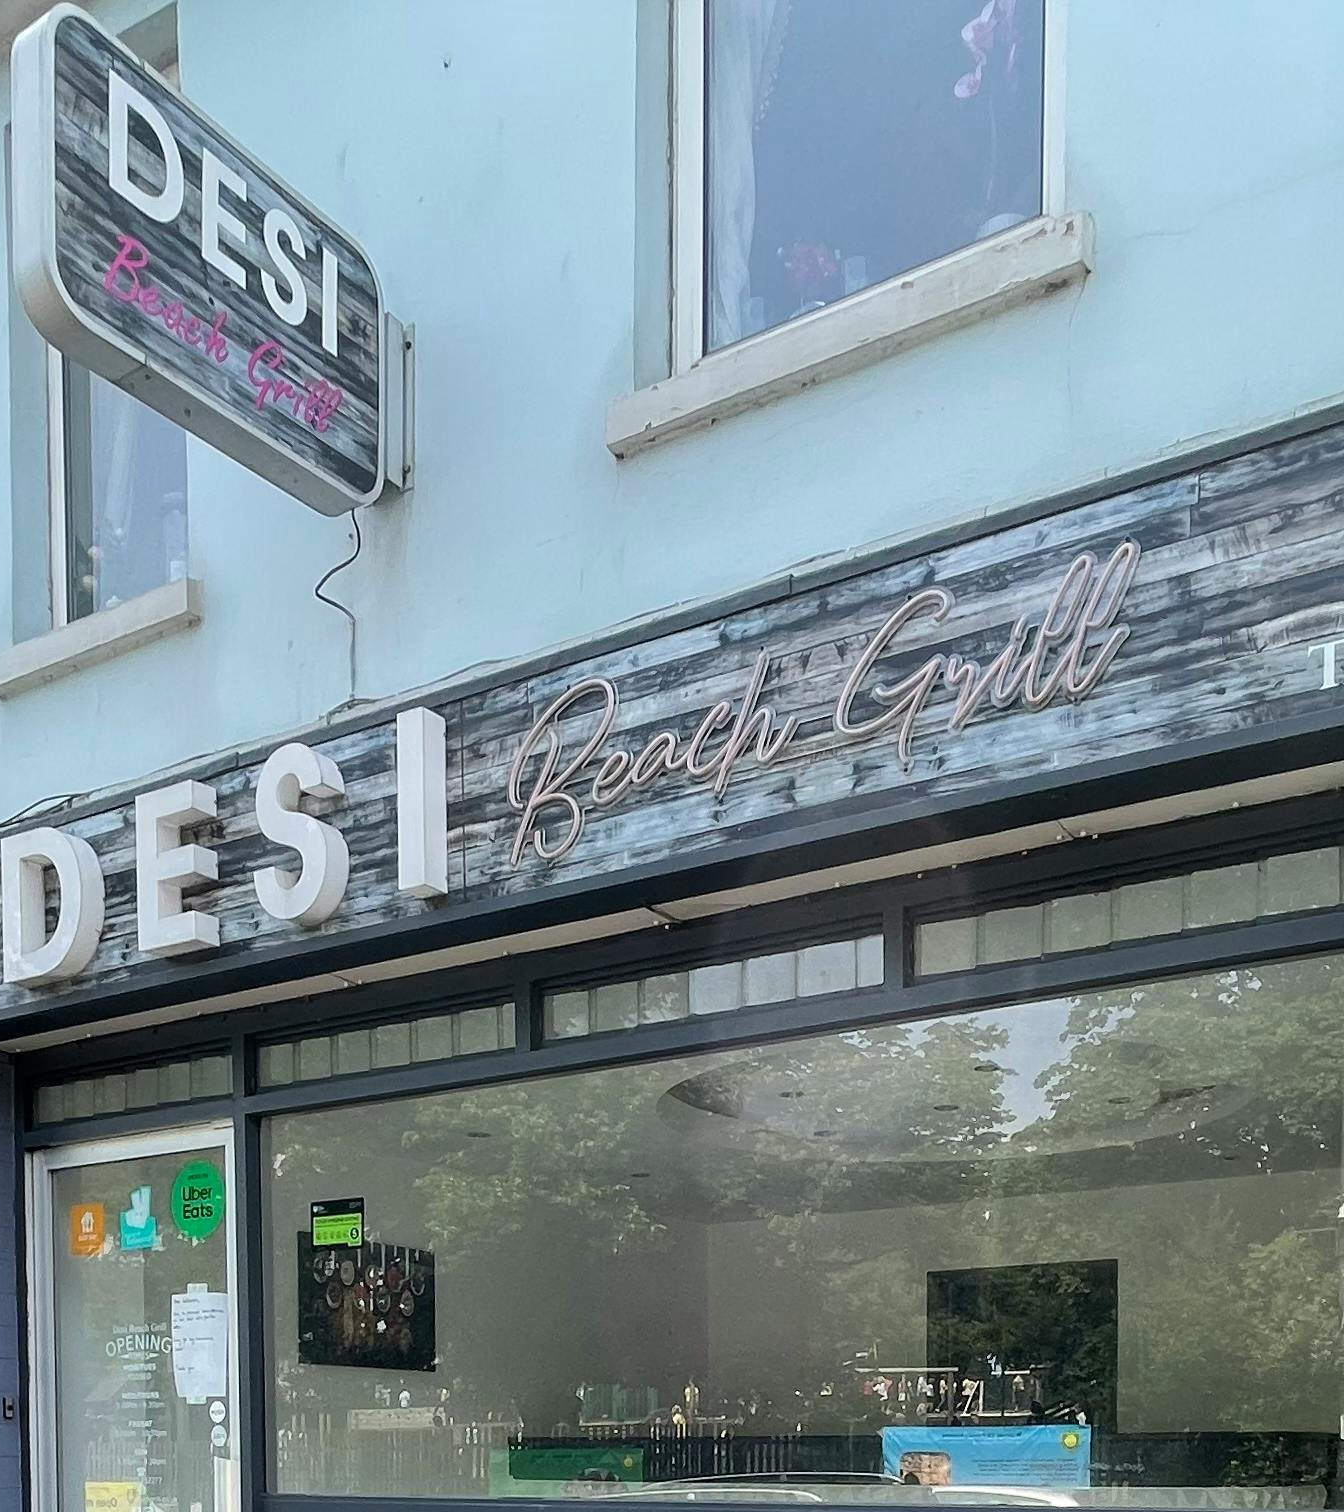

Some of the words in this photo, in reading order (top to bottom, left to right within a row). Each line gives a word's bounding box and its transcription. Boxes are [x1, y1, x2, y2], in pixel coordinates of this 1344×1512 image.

[107, 66, 339, 359] DESI
[102, 233, 231, 364] Beach
[247, 339, 345, 434] Grill
[0, 706, 449, 989] DESI
[507, 646, 797, 869] Beach
[834, 537, 1142, 775] Grill
[182, 1186, 213, 1201] Uber
[183, 1204, 214, 1219] Eats
[105, 1333, 172, 1358] OPENING
